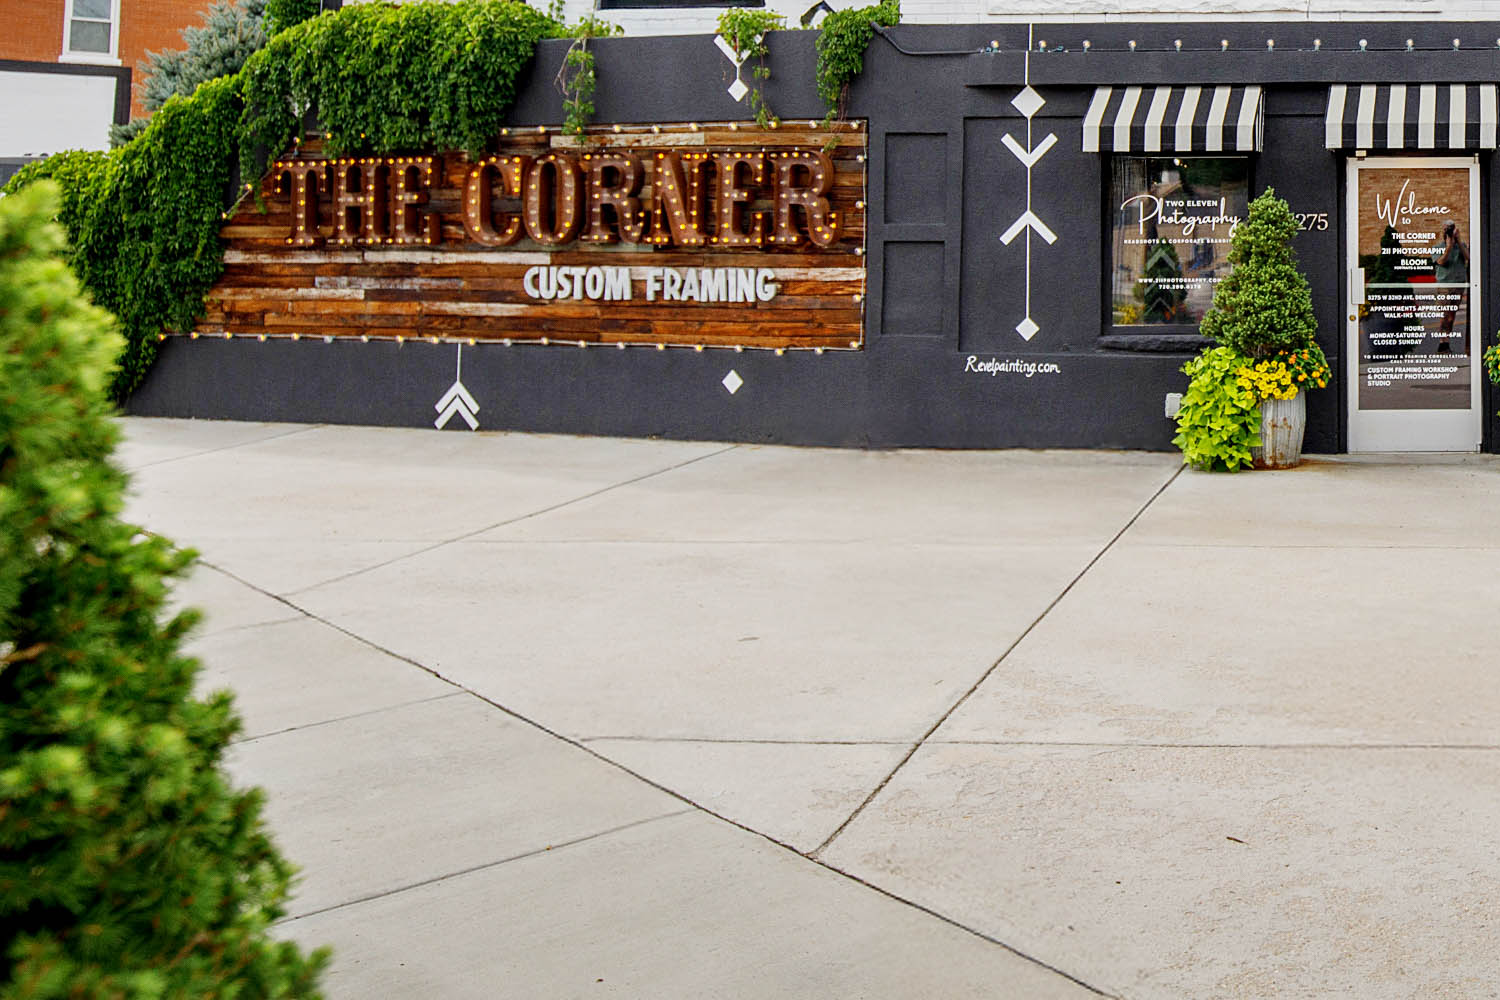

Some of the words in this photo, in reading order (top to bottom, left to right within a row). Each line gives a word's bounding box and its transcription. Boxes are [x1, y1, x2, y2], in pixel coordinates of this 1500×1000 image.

[274, 154, 442, 246] THE
[462, 151, 844, 246] CORNER
[1376, 178, 1450, 228] Welcome
[1120, 194, 1241, 238] Photography
[1290, 213, 1329, 231] 275
[1401, 217, 1411, 225] to
[1406, 232, 1436, 240] CORNER
[1392, 247, 1446, 255] PHOTOGRAPHY
[523, 266, 633, 301] CUSTOM
[645, 267, 779, 303] FRAMING
[964, 355, 1061, 378] Revelpainting.com
